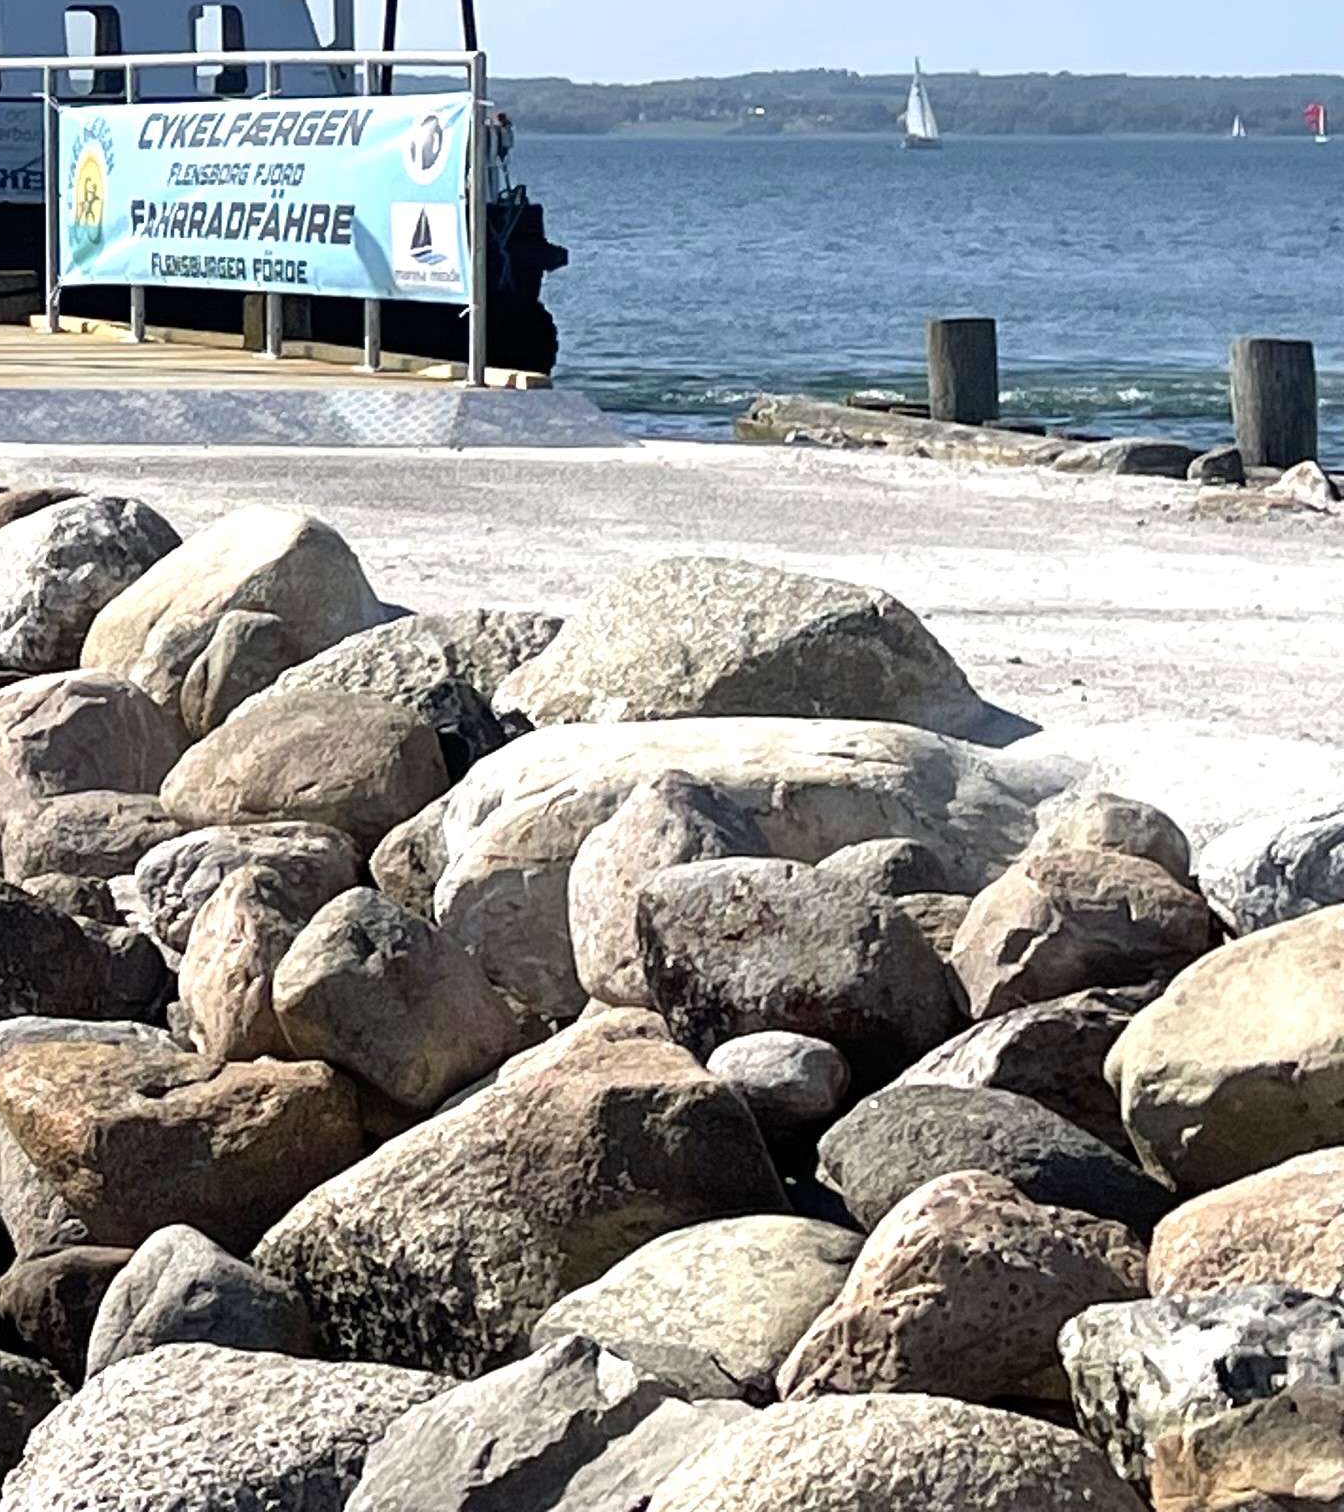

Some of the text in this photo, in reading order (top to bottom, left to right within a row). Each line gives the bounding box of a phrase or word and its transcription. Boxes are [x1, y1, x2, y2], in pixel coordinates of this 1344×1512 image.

[137, 107, 371, 151] CYKELFÆRGEN
[167, 162, 305, 187] FLENSBORG FJORD
[130, 189, 356, 245] FAHRRADFÄHRE
[151, 249, 307, 284] FLENSBURGER FÖRDE
